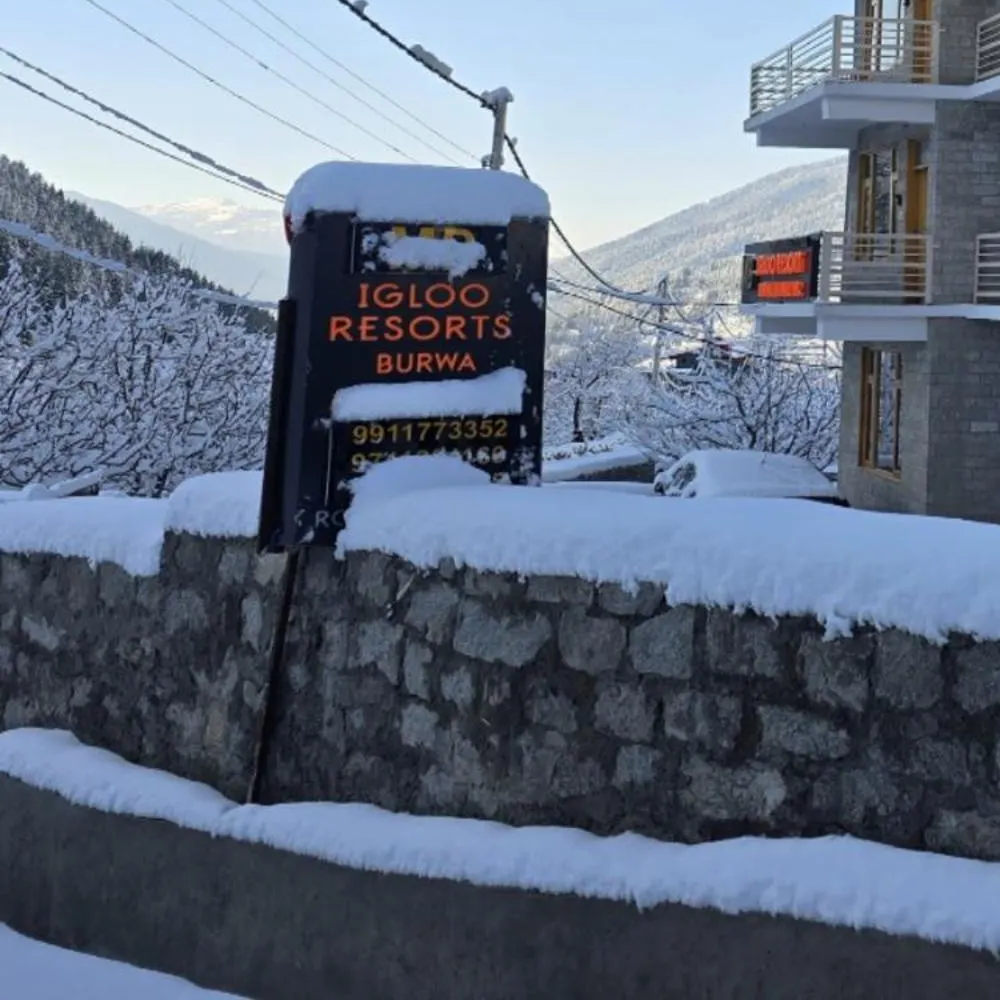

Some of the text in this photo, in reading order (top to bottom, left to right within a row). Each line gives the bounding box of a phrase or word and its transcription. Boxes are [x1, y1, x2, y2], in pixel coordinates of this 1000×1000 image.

[357, 282, 490, 309] IGLOO
[329, 315, 513, 342] RESORTS
[375, 352, 477, 375] BURWA
[351, 418, 508, 446] 9911773352
